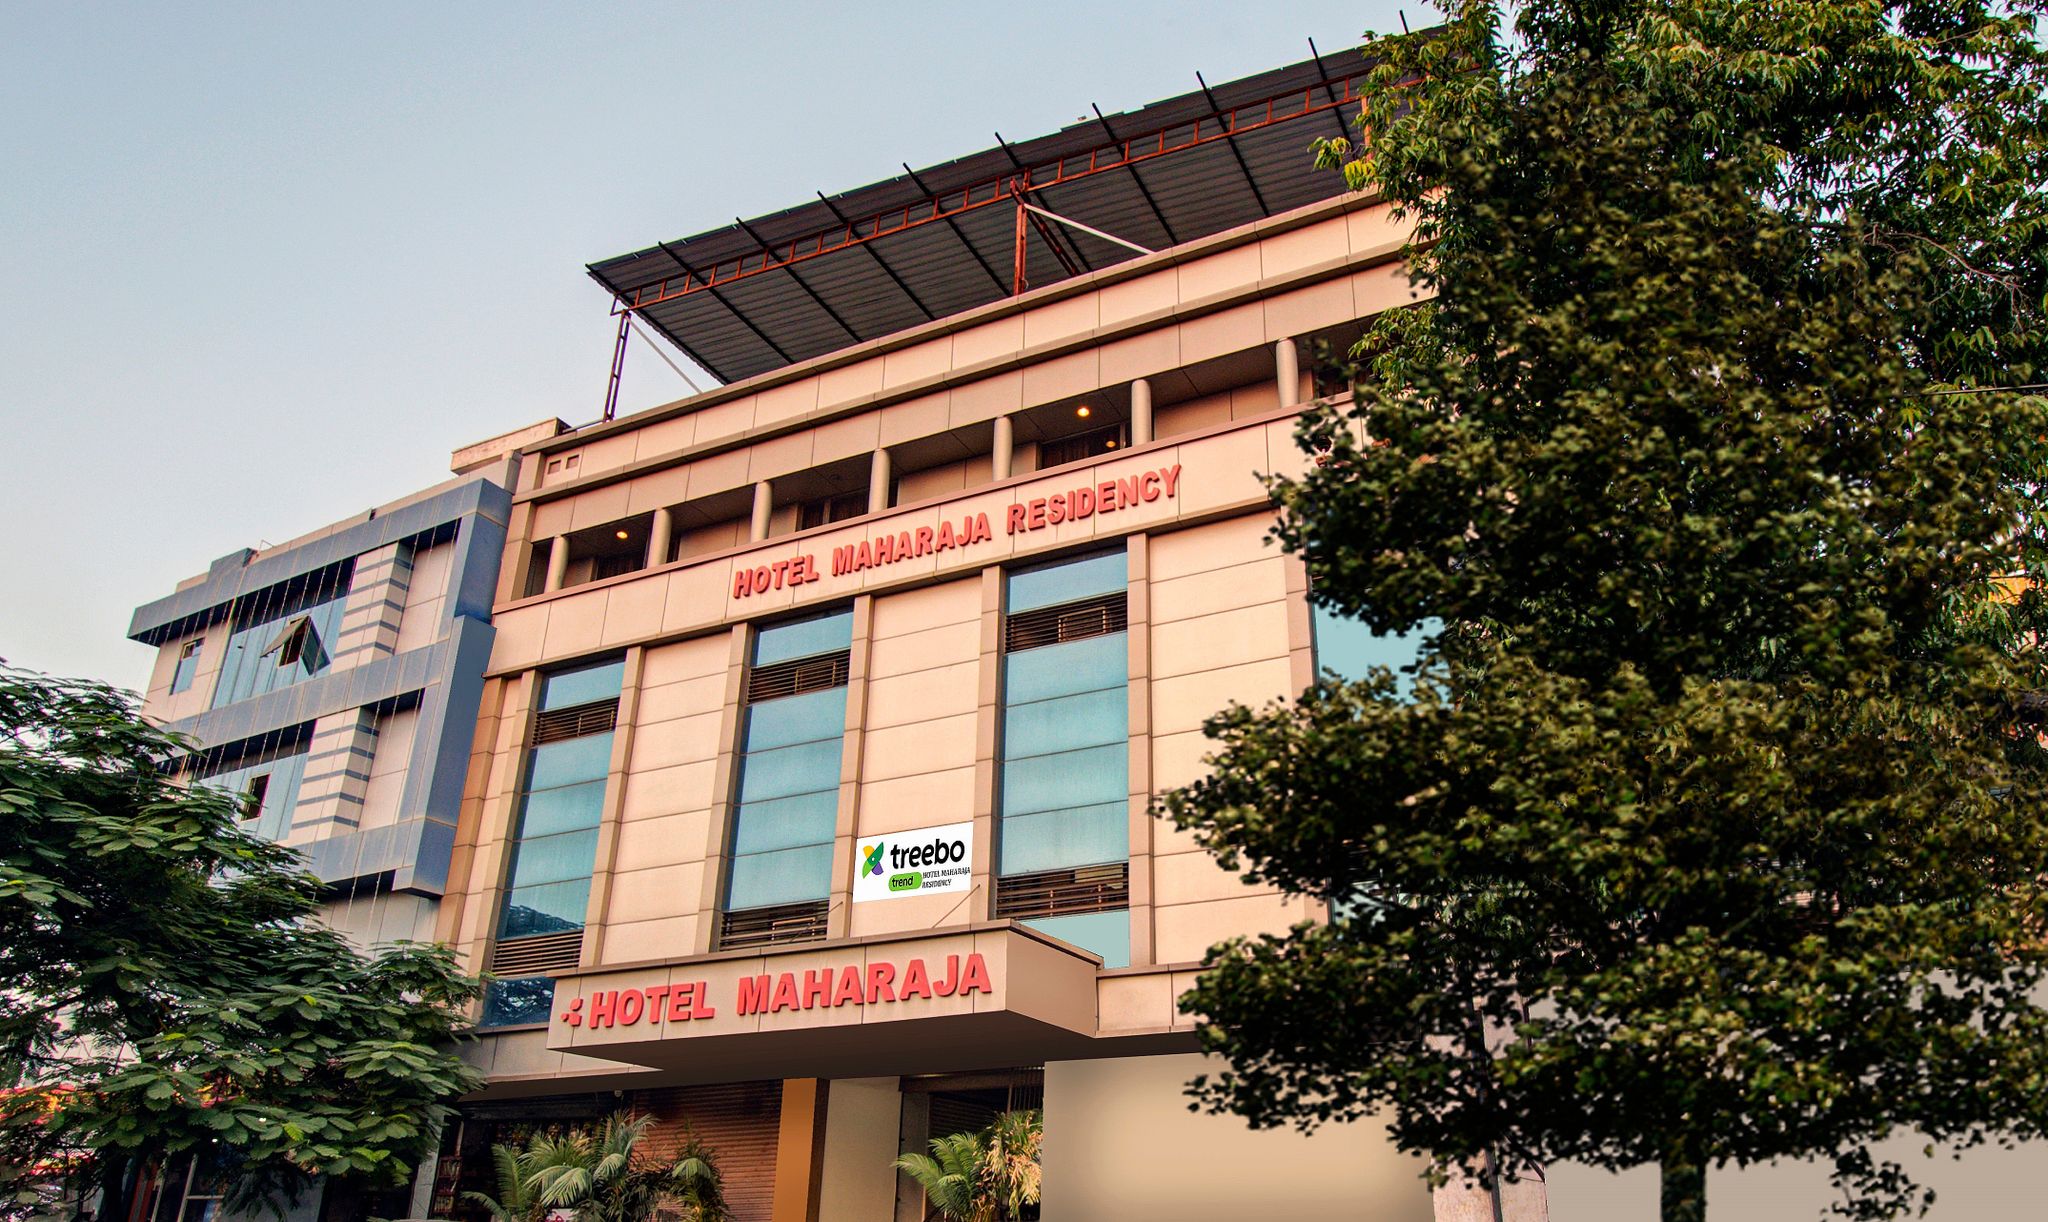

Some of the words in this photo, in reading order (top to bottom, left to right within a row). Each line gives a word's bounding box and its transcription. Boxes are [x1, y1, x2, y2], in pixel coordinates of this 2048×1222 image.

[733, 553, 819, 599] HOTEL
[832, 512, 992, 576] MAHARAJA
[1006, 464, 1182, 535] RESIDENCY
[890, 838, 965, 869] treebo
[892, 876, 914, 888] trend
[922, 871, 941, 879] HOTEL
[588, 981, 715, 1029] HOTEL
[737, 953, 992, 1016] MAHARAJA
